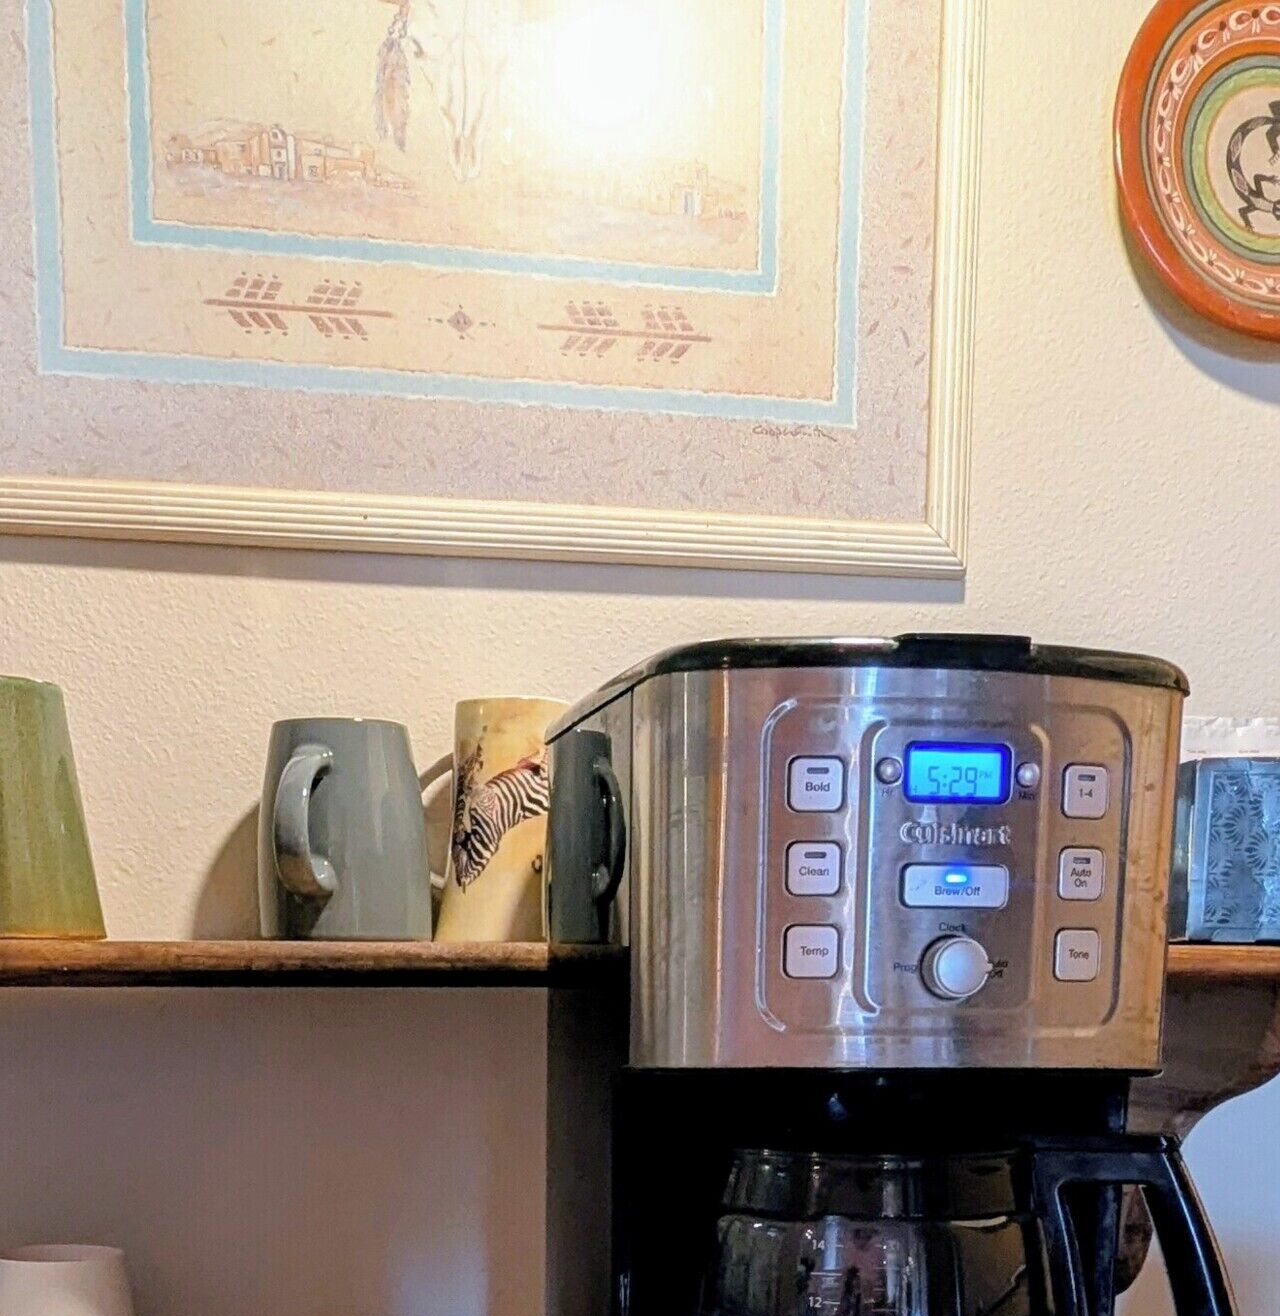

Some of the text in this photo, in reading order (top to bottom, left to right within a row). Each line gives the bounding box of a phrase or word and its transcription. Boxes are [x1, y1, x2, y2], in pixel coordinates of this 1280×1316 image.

[805, 781, 830, 792] Bold
[928, 766, 978, 796] 5:29
[799, 866, 830, 877] Clean
[1070, 867, 1092, 878] Auto
[1074, 878, 1087, 888] On
[934, 885, 981, 897] Brew/Off
[939, 922, 967, 932] Clock
[800, 945, 830, 958] Temp
[1069, 948, 1090, 960] Tone
[812, 1240, 825, 1250] 14
[808, 1297, 822, 1308] 12
